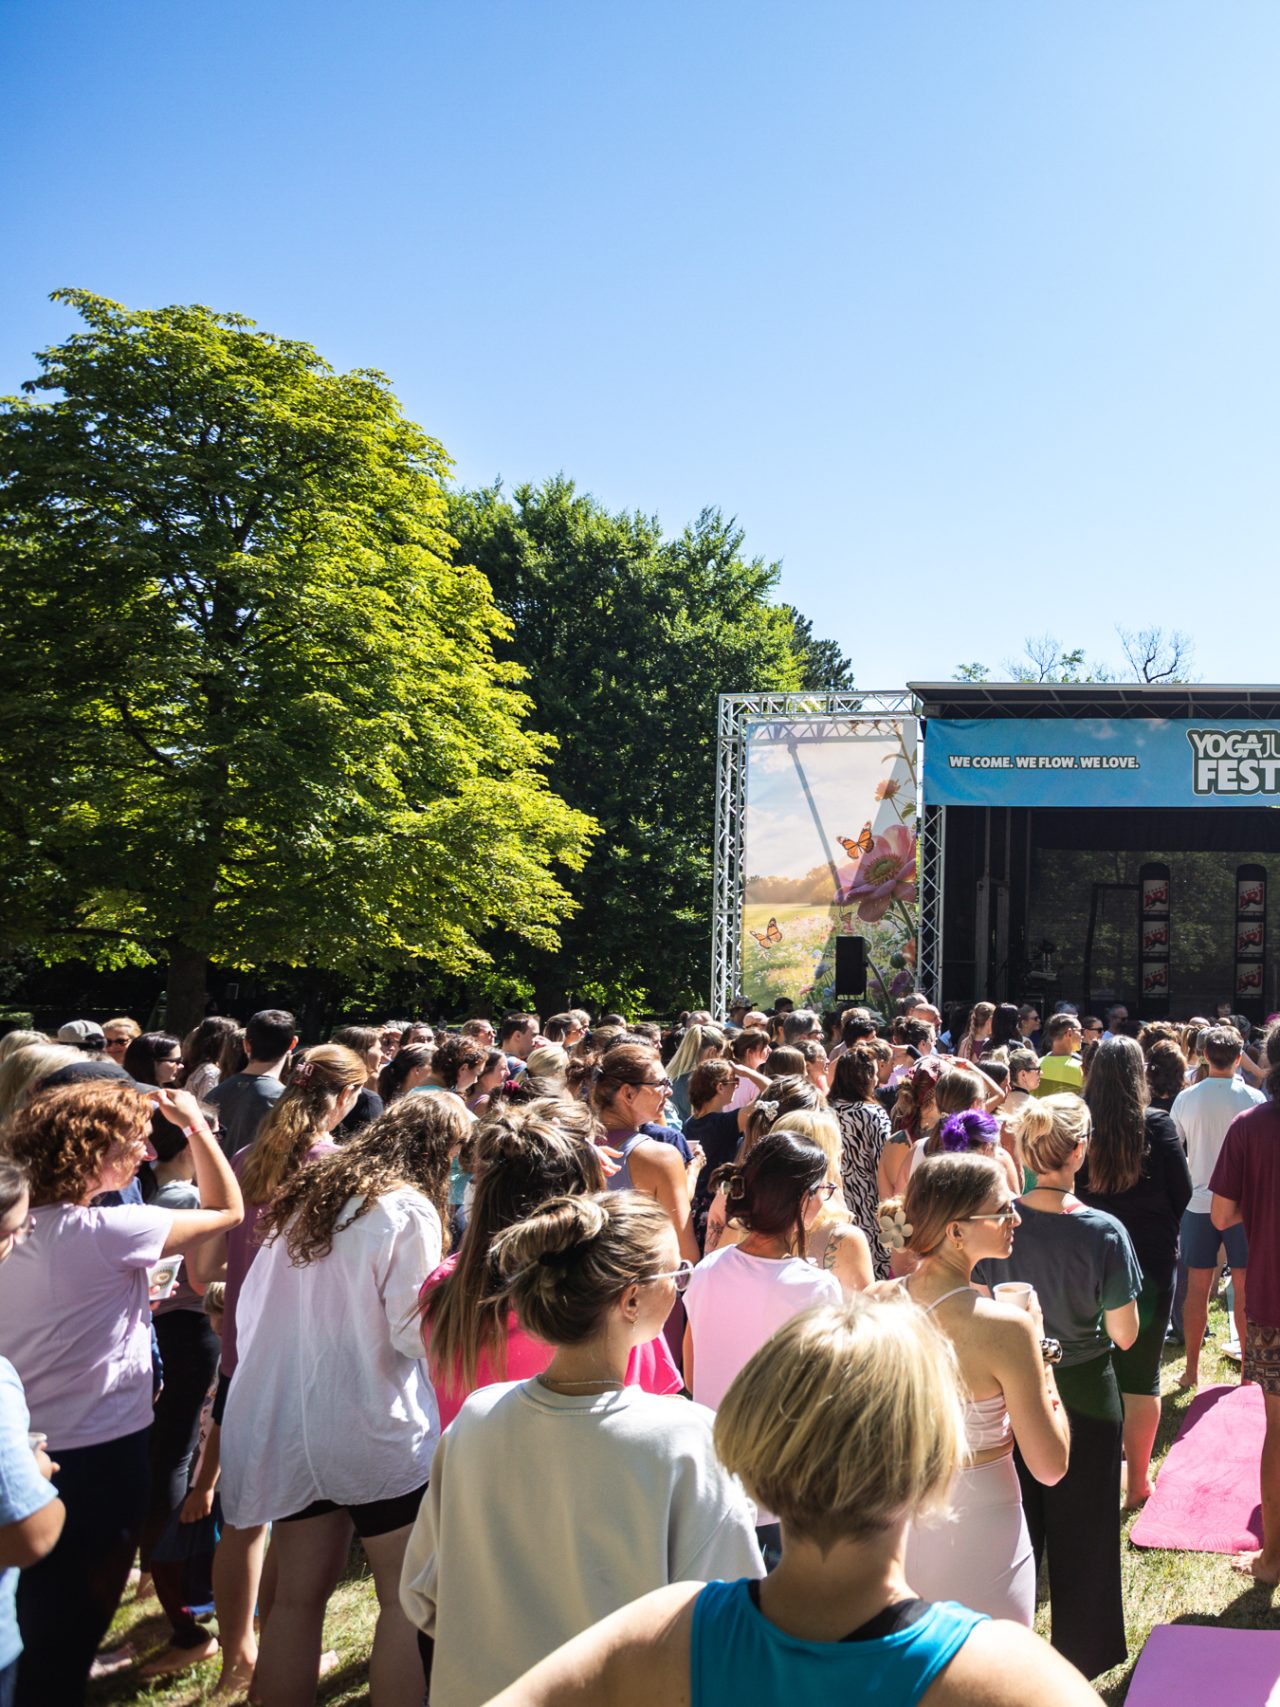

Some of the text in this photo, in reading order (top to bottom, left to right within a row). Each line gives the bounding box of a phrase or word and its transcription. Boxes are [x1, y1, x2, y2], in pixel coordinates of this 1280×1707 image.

[949, 756, 1140, 769] WE COME. WE FLOW. WE LOVE.
